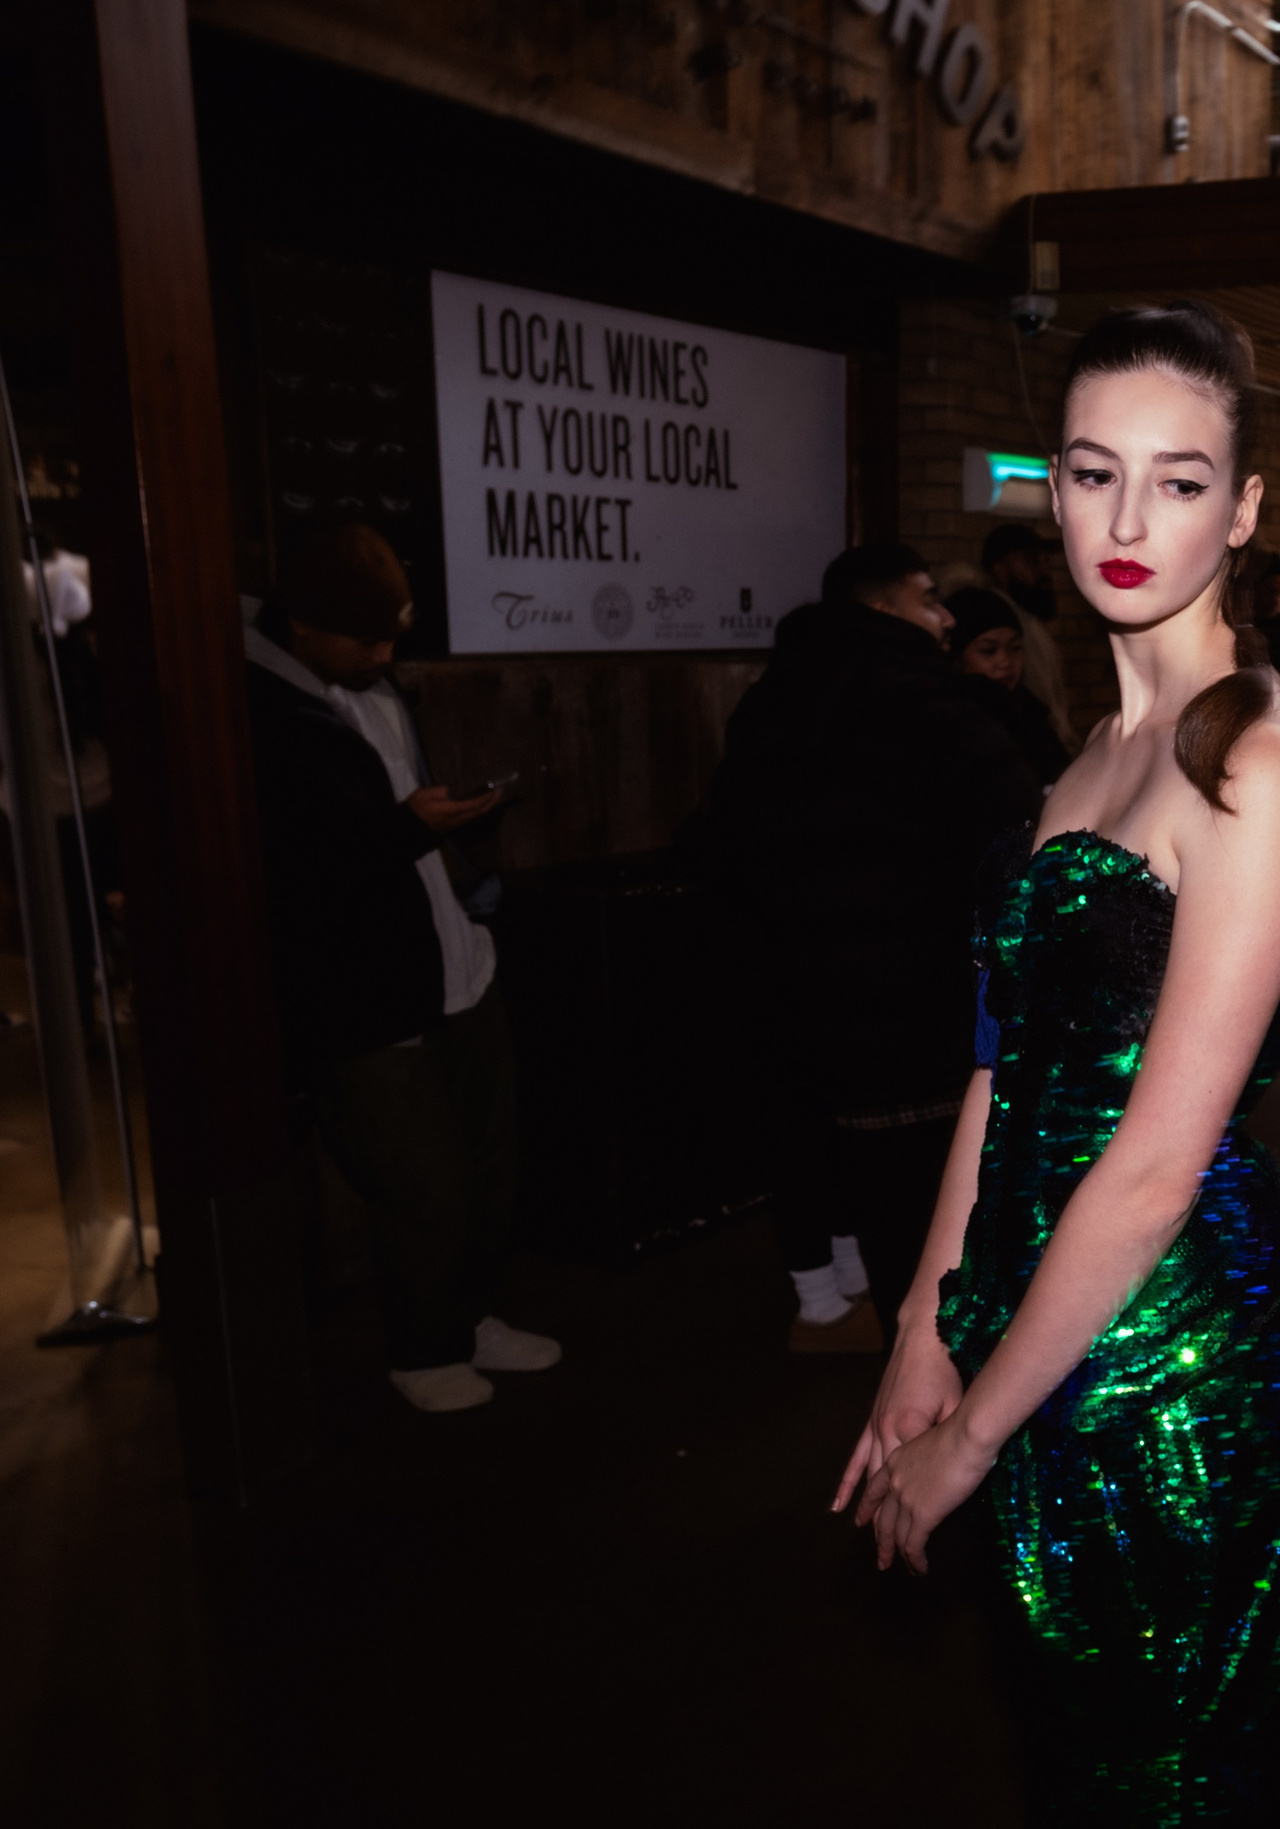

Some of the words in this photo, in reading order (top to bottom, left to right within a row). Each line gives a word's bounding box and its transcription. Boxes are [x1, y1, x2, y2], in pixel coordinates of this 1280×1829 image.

[857, 0, 1026, 160] HOP
[477, 303, 594, 391] LOCAL
[604, 328, 709, 408] WINES
[483, 397, 524, 469] AT
[537, 405, 633, 481] YOUR
[644, 418, 738, 490] LOCAL
[485, 488, 640, 563] MARKET.
[491, 590, 574, 630] Trius
